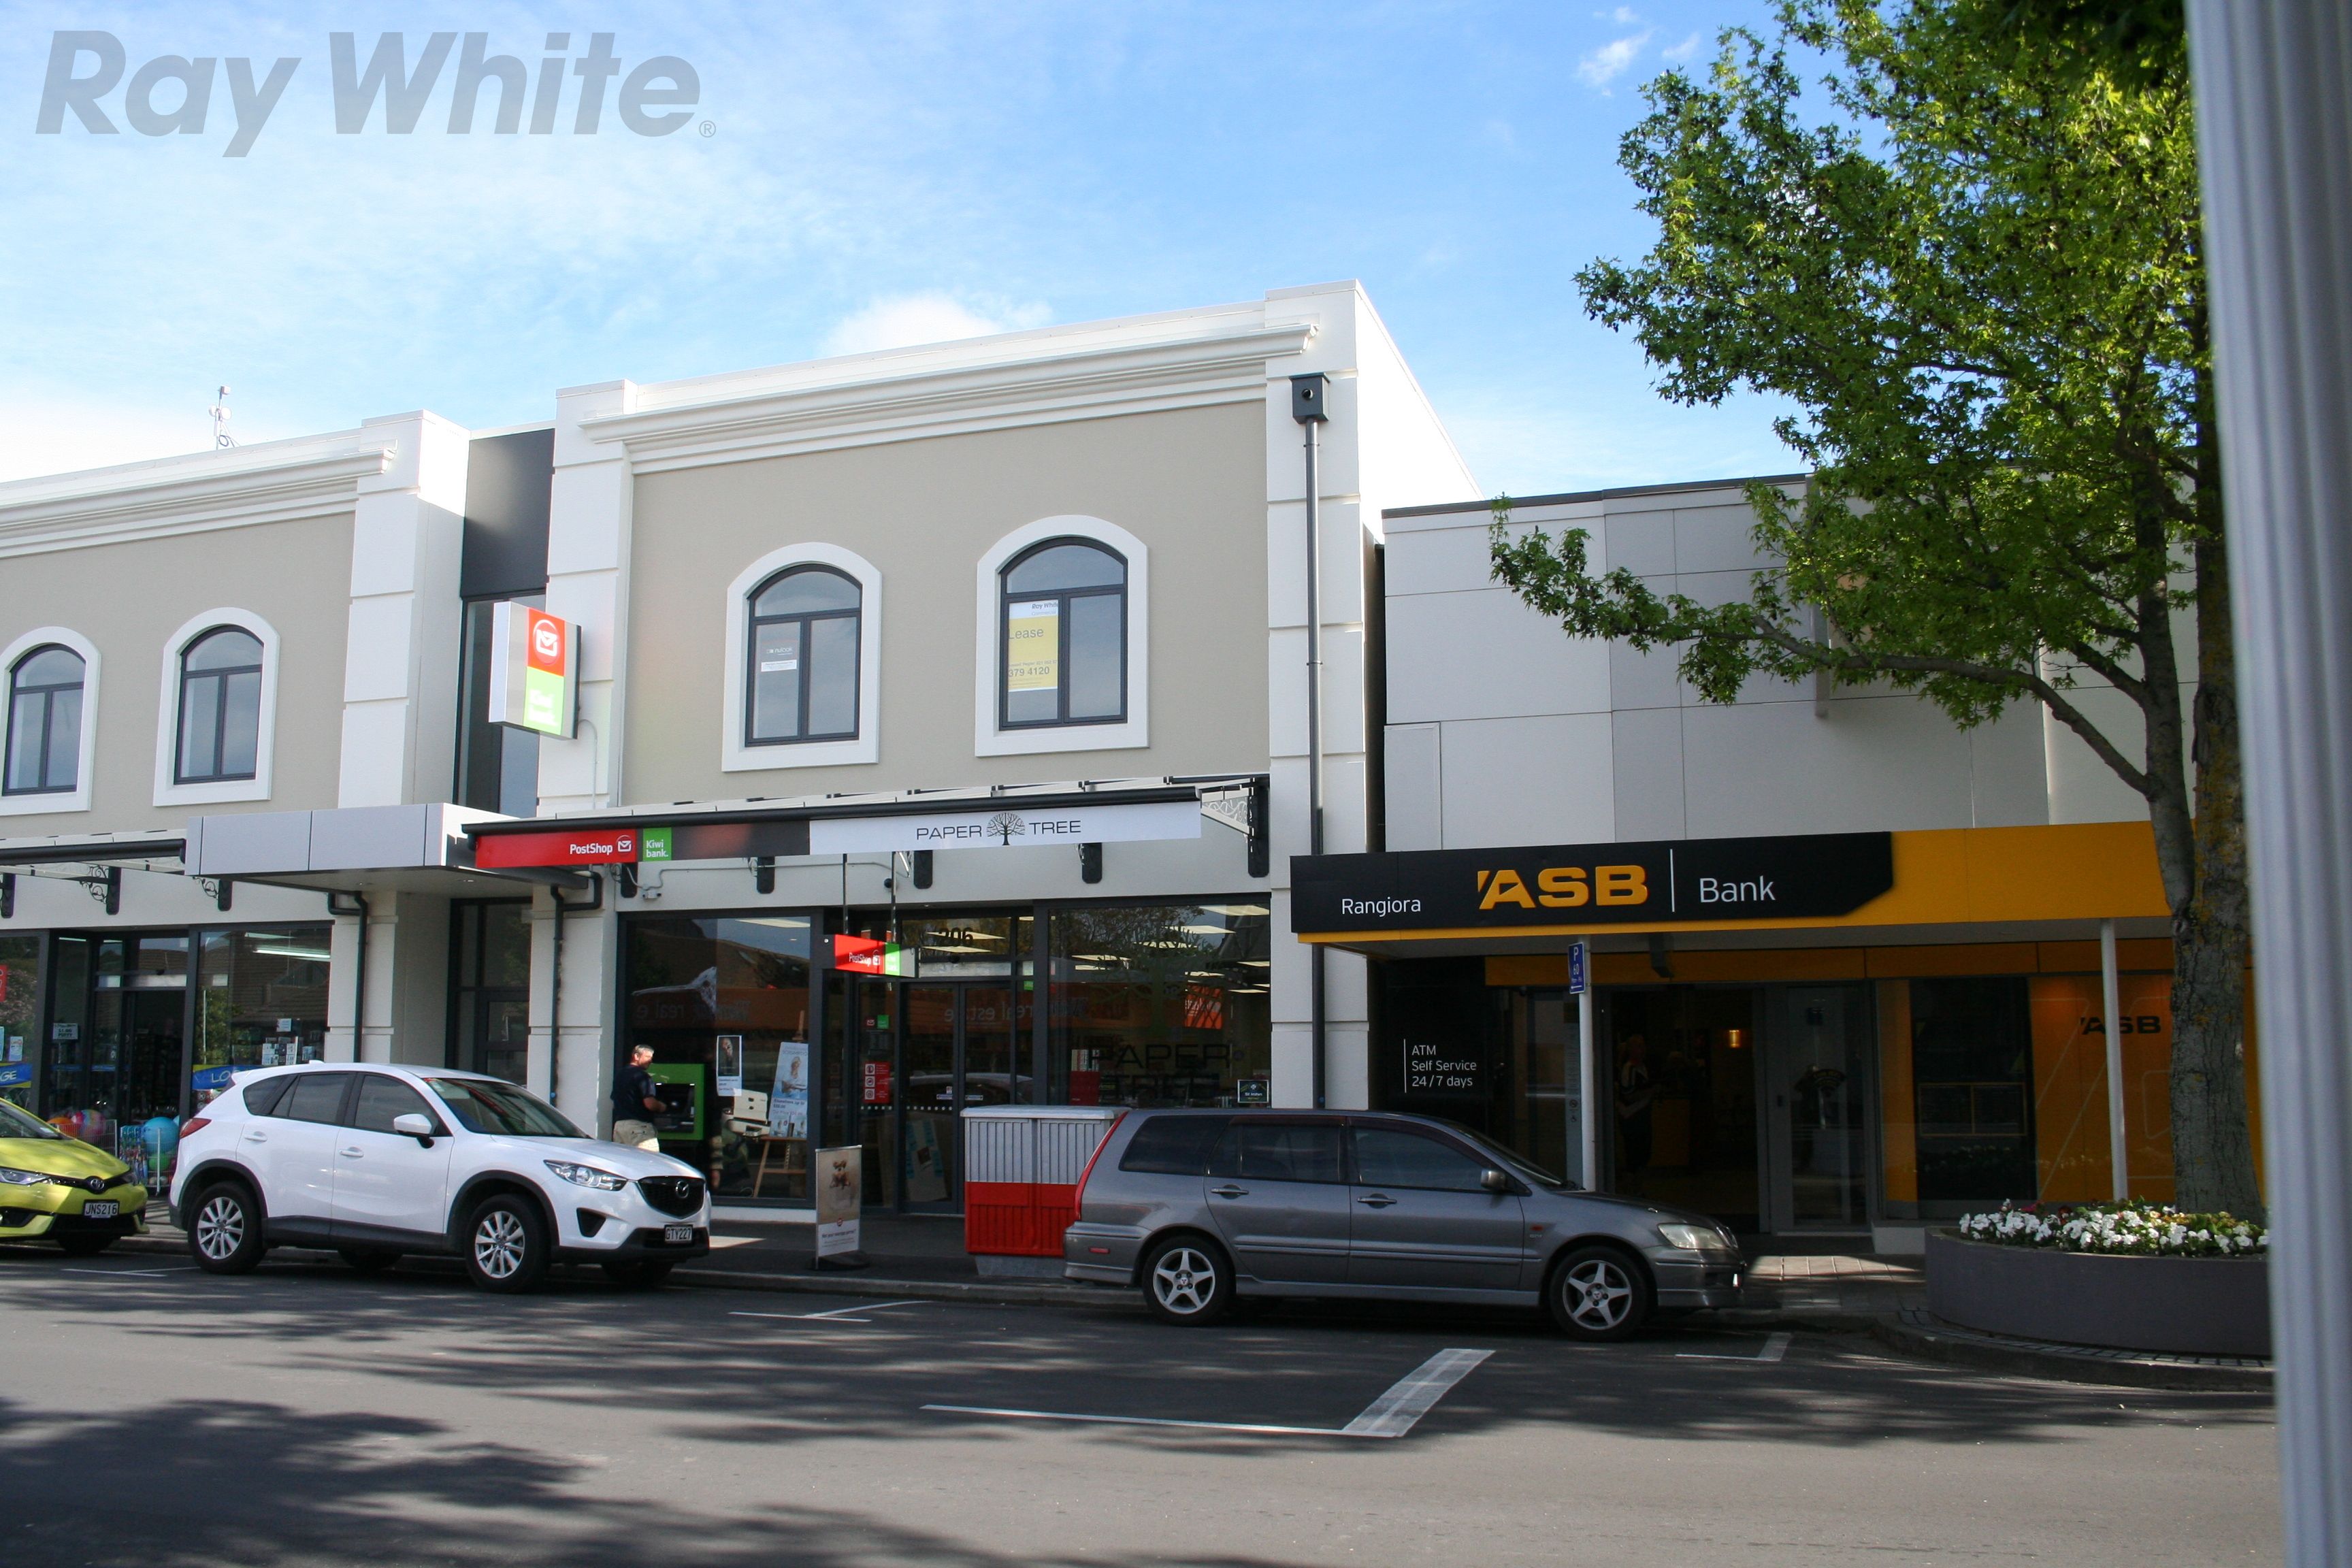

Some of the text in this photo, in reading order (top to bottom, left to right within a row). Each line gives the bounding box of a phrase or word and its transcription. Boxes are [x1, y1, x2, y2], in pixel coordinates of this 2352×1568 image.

[1009, 666, 1050, 677] 379 4120
[917, 820, 1081, 840] PAPER TREE
[569, 843, 613, 855] PostShop
[647, 839, 664, 849] Kiwi
[647, 849, 669, 858] bank.
[1341, 865, 1776, 919] Rangiora ASB Bank
[849, 951, 872, 967] PostShop
[1573, 947, 1579, 961] P
[1089, 1043, 1231, 1069] PAPER
[1411, 1045, 1436, 1056] ATM
[1411, 1060, 1477, 1071] Self Service
[1446, 1075, 1473, 1088] days
[85, 1204, 117, 1215] JNS216
